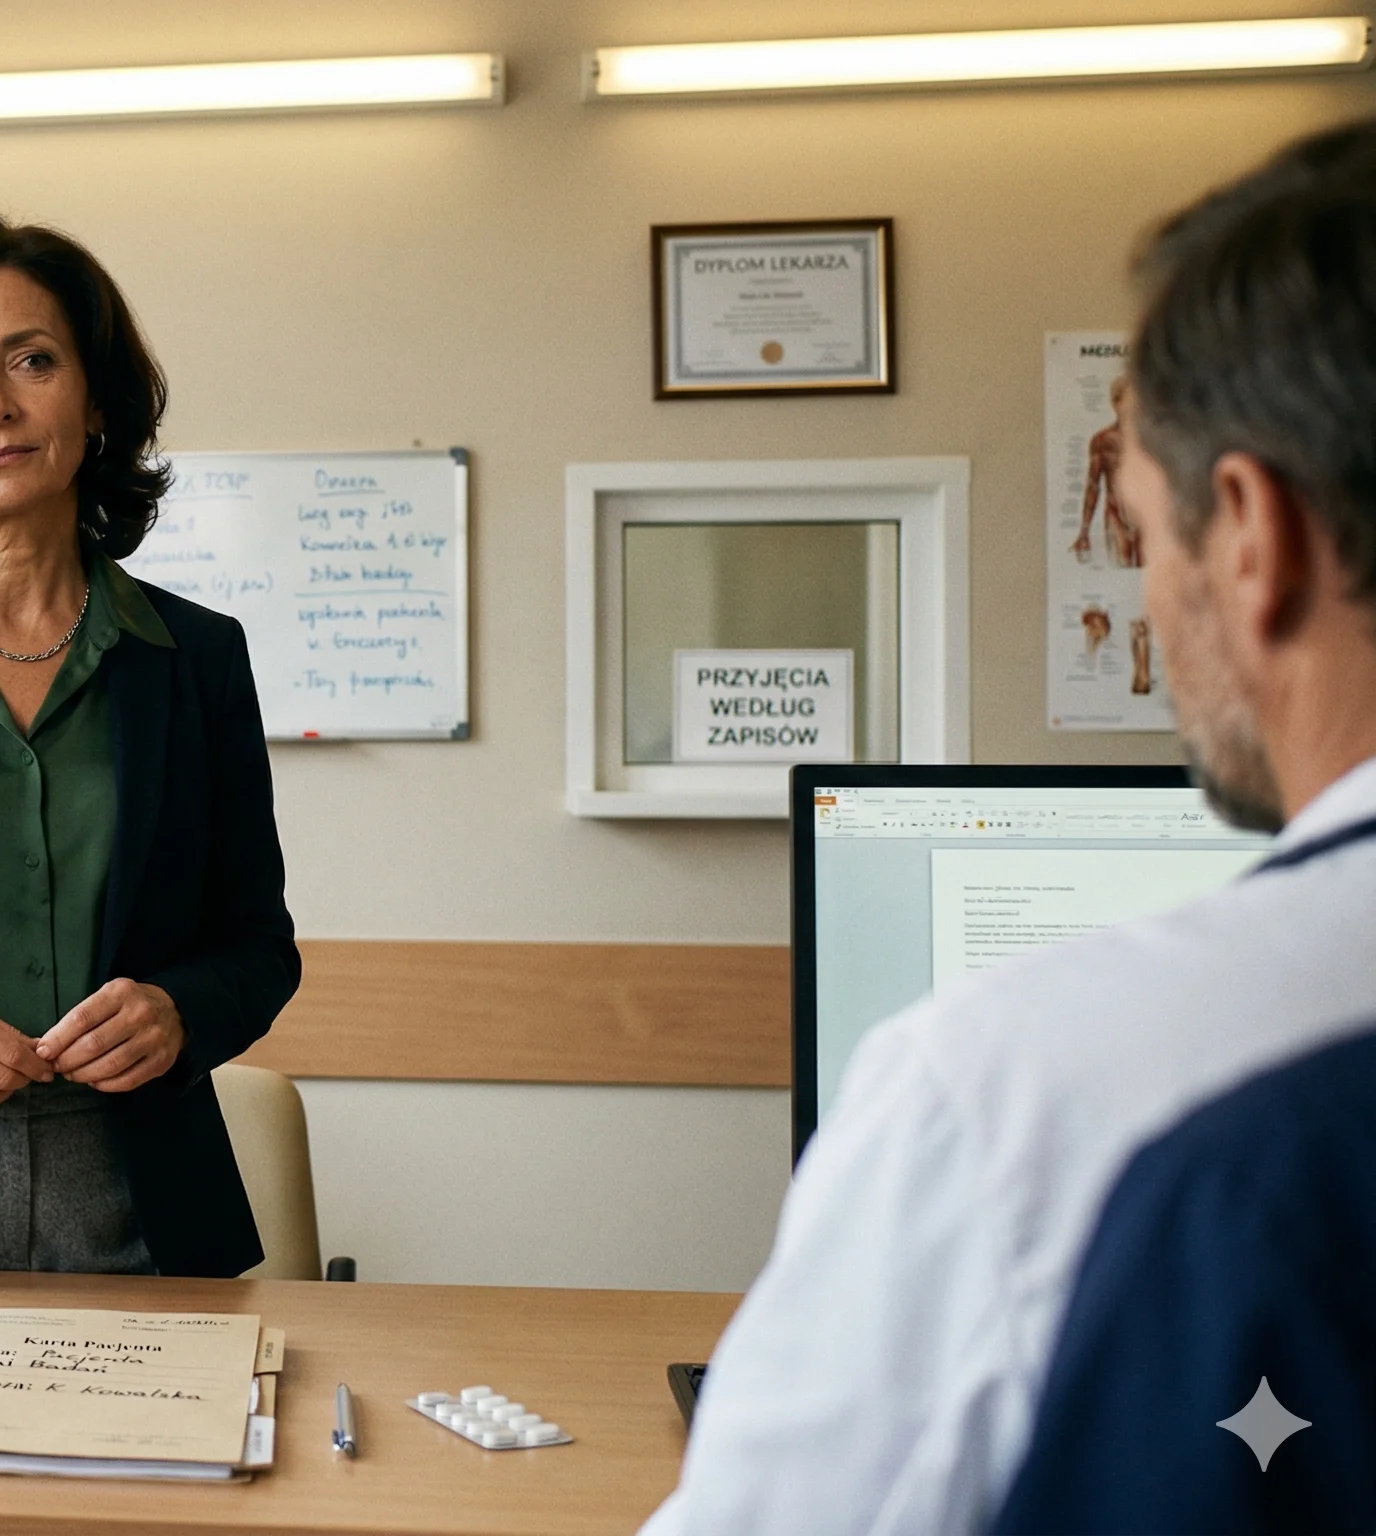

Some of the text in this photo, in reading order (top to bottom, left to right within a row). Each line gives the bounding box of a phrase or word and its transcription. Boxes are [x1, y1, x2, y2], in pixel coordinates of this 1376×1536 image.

[694, 254, 849, 274] DYPLOM LEKARZA
[697, 667, 830, 692] PRZYJĘCIA
[710, 697, 815, 717] WEDŁUG
[707, 723, 819, 746] ZAPISÓW
[24, 1336, 162, 1352] Karta Pacjenta
